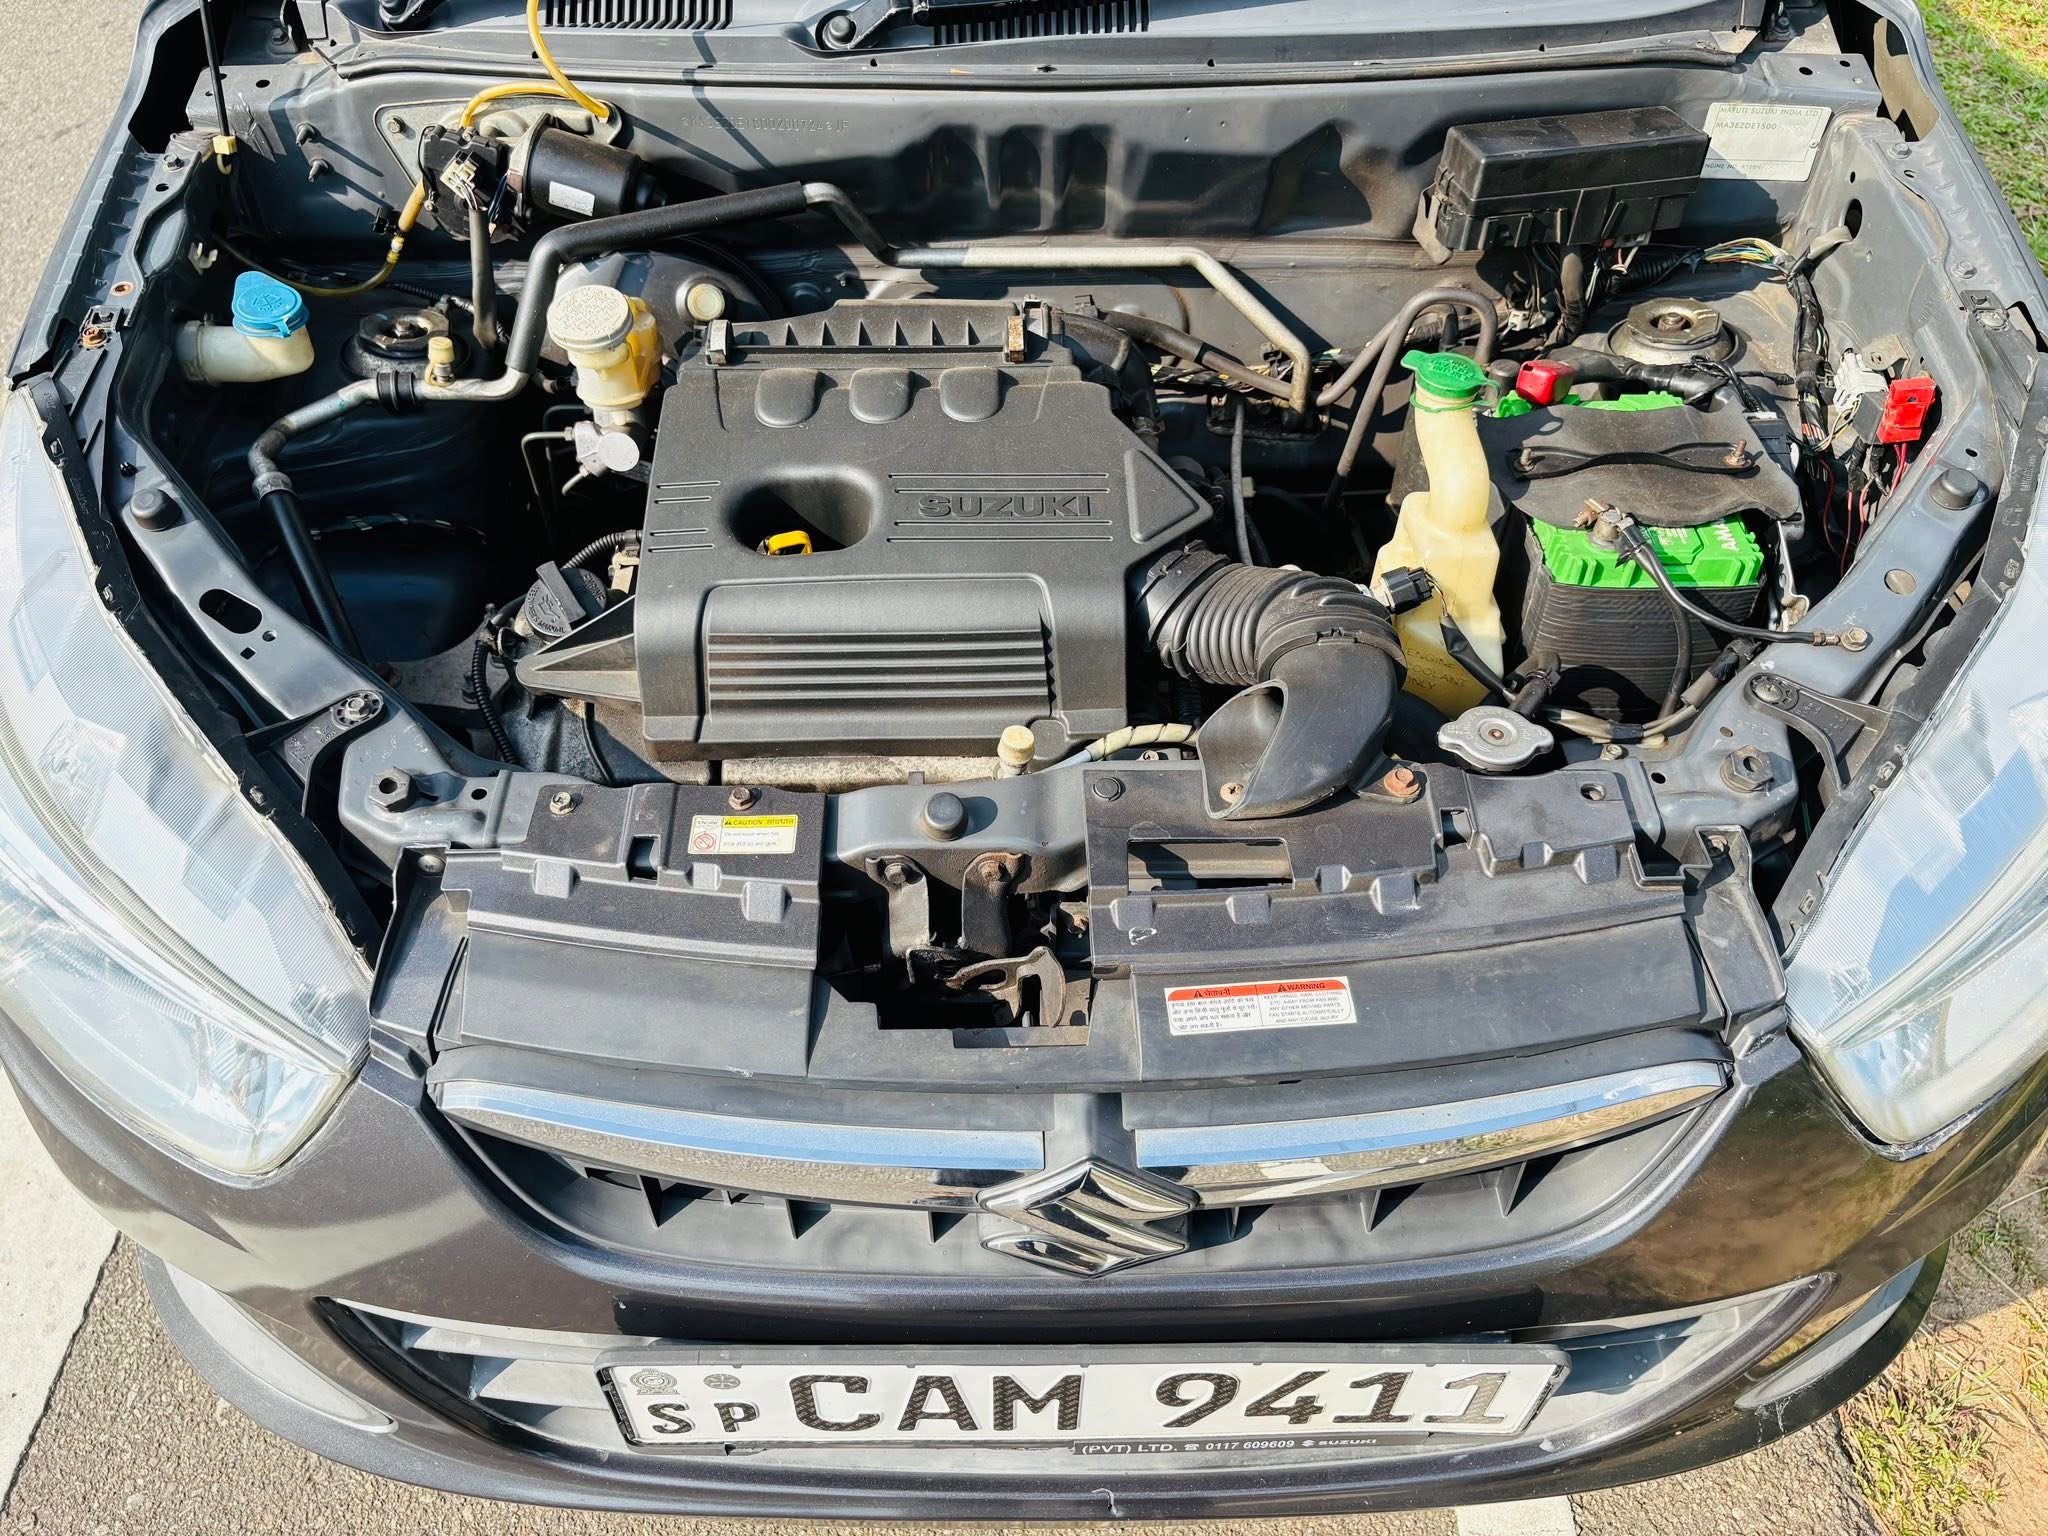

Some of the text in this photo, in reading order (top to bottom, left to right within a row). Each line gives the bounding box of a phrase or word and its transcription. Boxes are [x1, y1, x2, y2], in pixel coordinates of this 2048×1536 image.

[1750, 107, 1778, 115] SUZUKI
[919, 495, 1091, 518] SUZUKI
[1286, 982, 1326, 991] WARNING
[789, 1370, 1512, 1432] CAM 9411
[1082, 1438, 1378, 1455] (PVT) LTD. 0117 609609 SUZUKI
